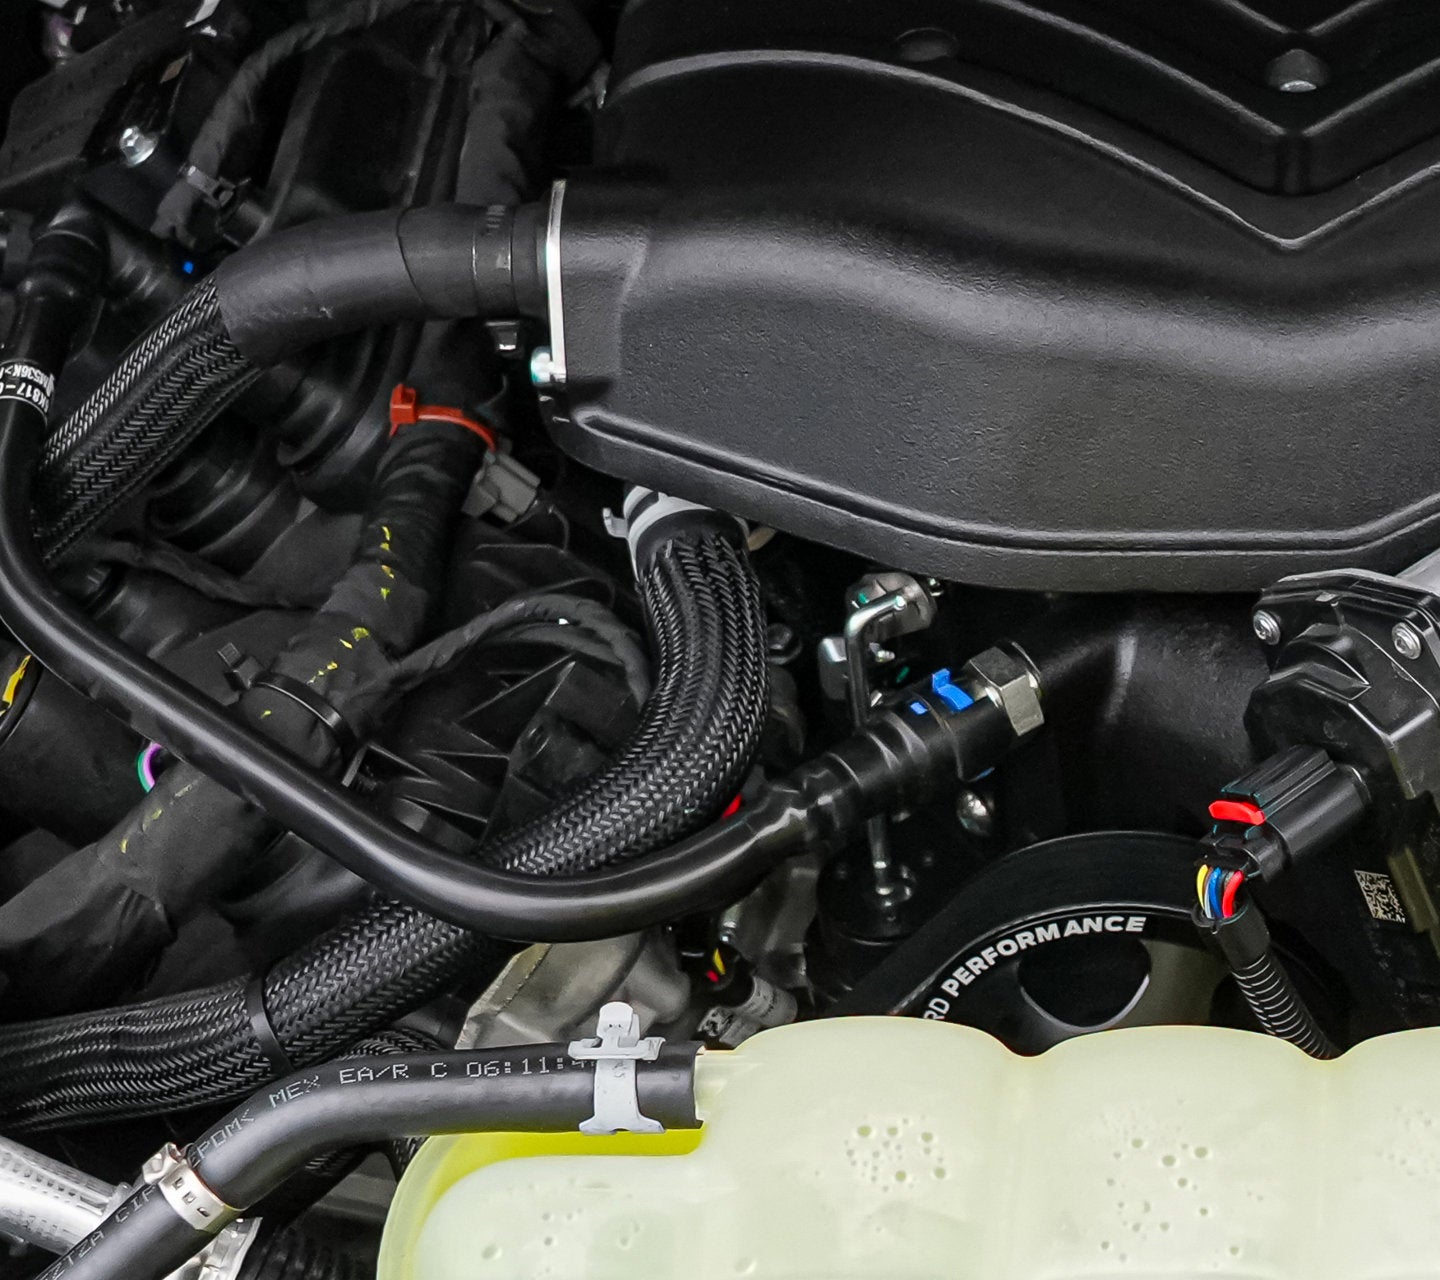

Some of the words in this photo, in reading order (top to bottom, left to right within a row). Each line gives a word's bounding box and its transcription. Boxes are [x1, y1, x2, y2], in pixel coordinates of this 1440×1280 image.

[941, 915, 1147, 998] PERFORMANCE
[269, 1075, 321, 1110] MEX
[339, 1063, 410, 1086] EA/R
